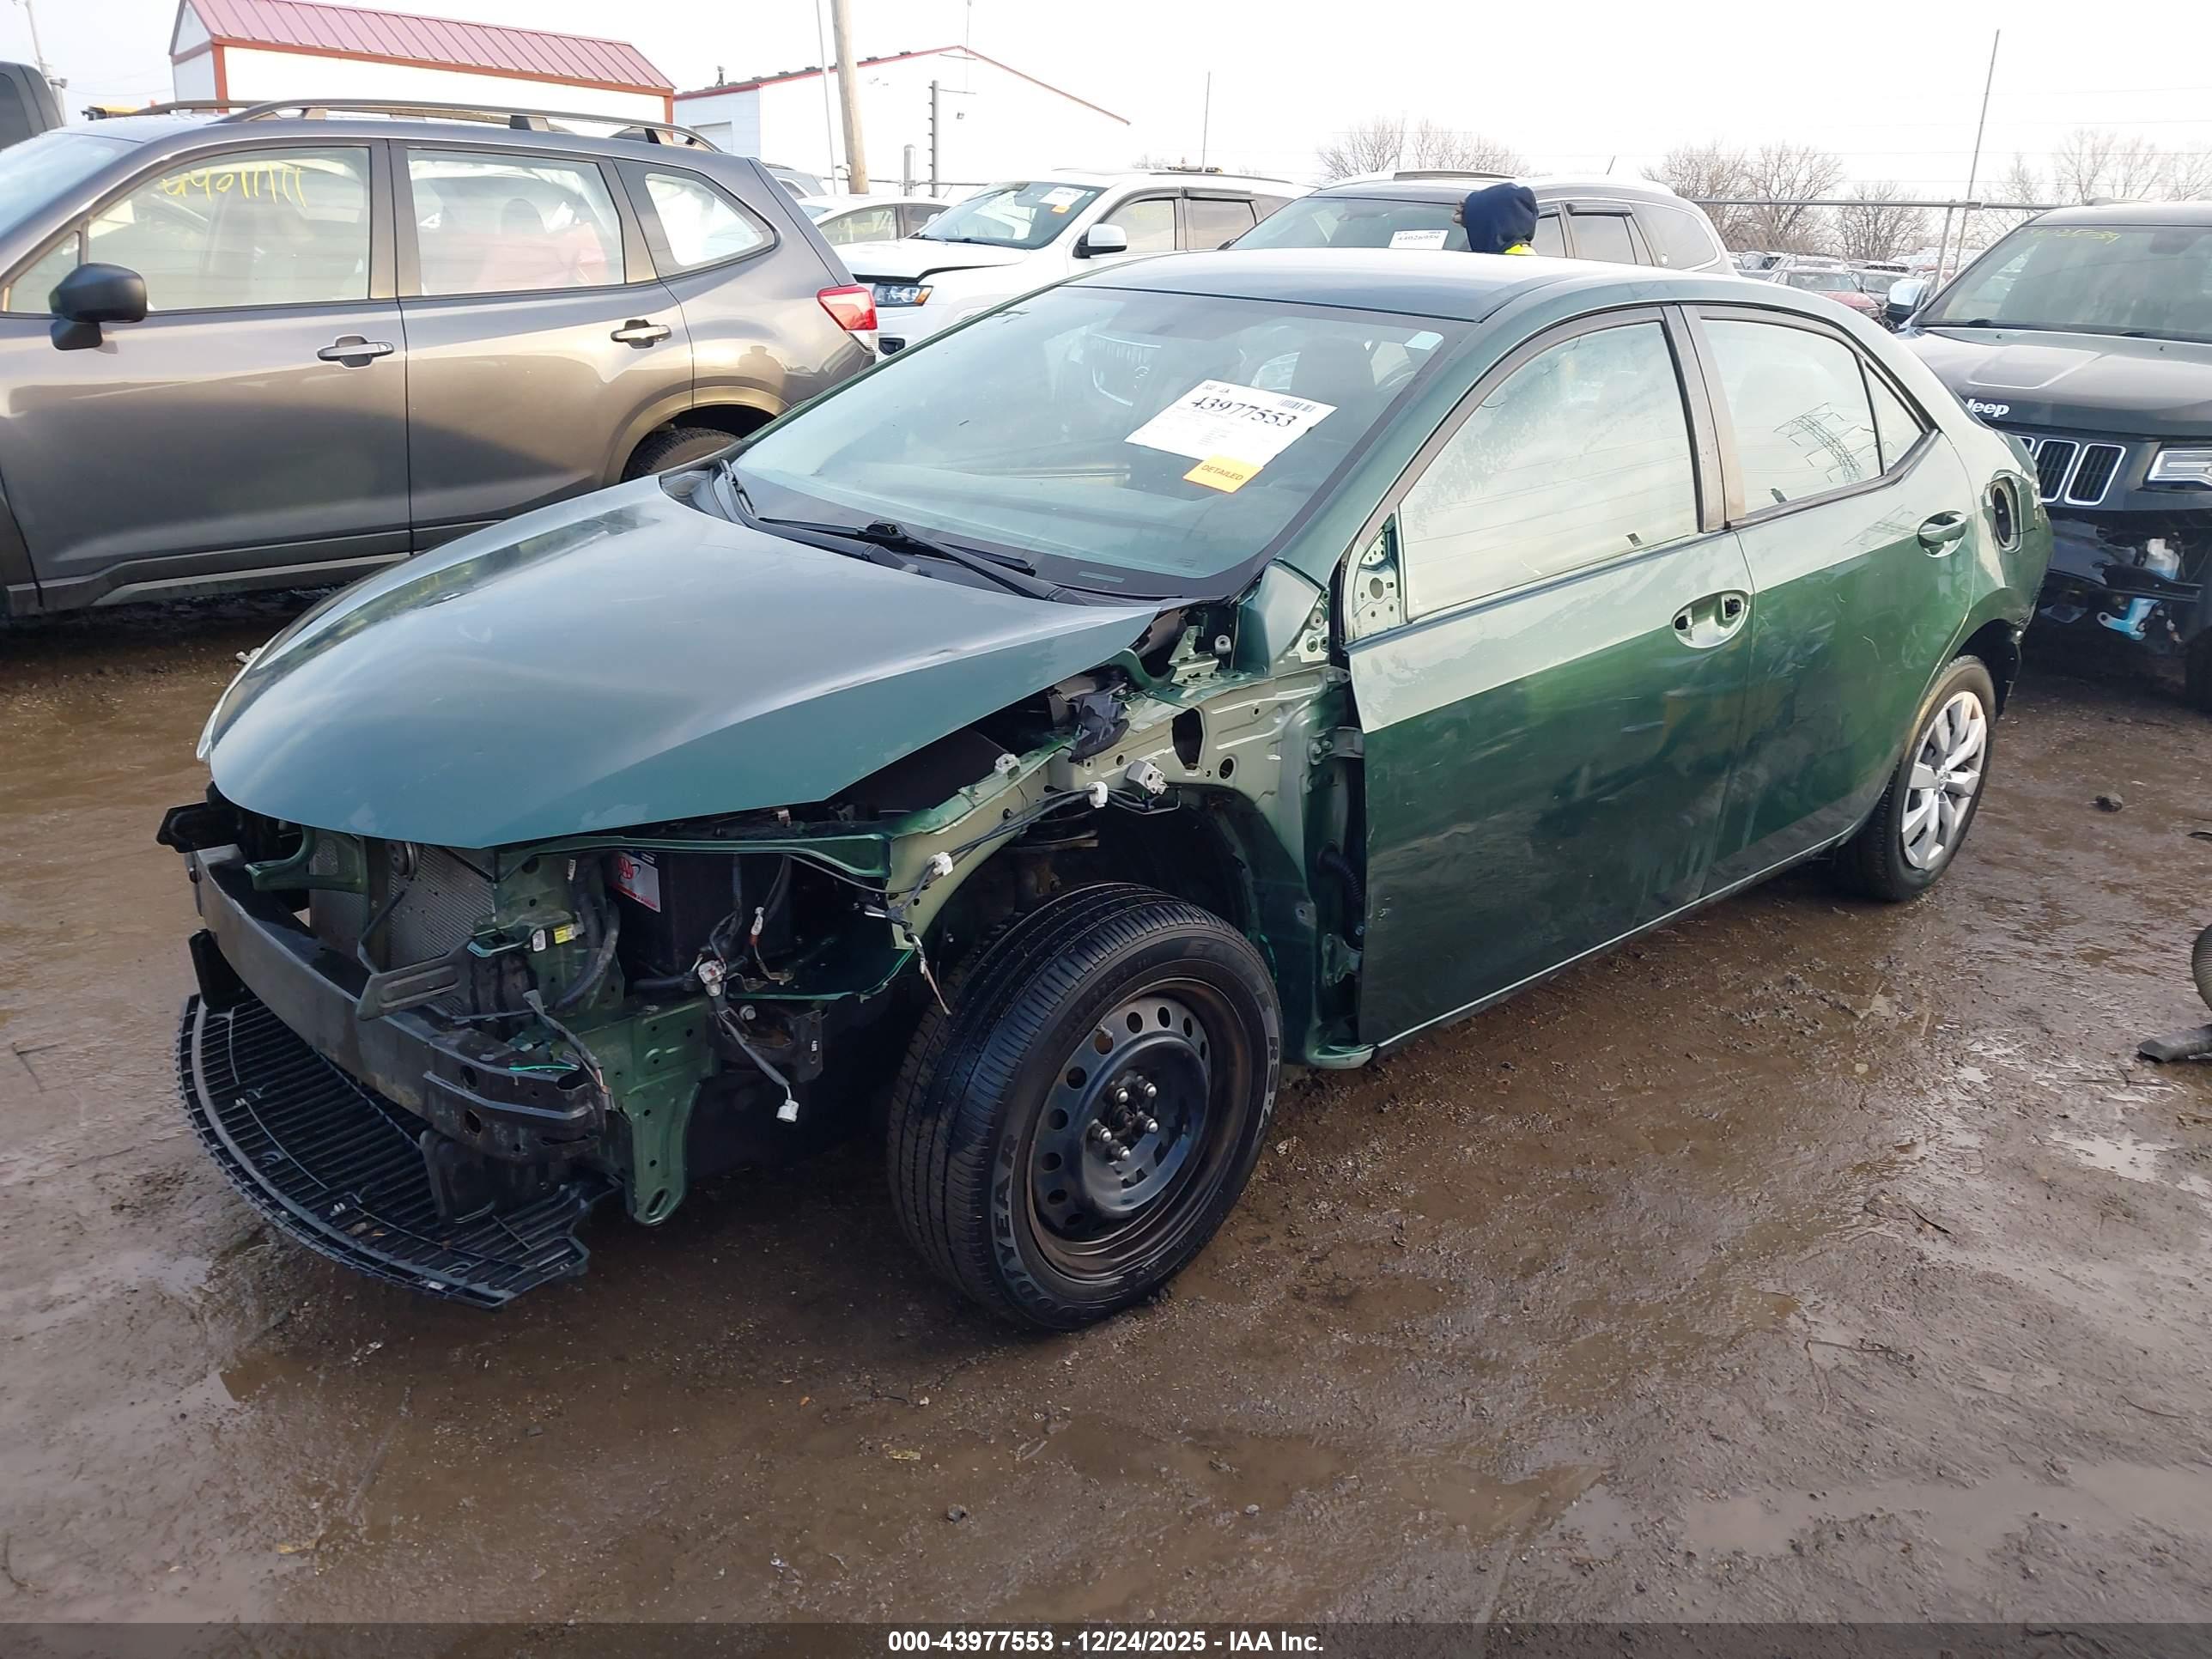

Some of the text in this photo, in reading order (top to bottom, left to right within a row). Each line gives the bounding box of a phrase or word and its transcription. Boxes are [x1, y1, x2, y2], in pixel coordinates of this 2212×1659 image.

[1190, 395, 1298, 428] 43977553
[1966, 398, 2010, 418] Jeep
[1200, 464, 1244, 482] DETAILED
[993, 1133, 1110, 1323] GOODYEAR
